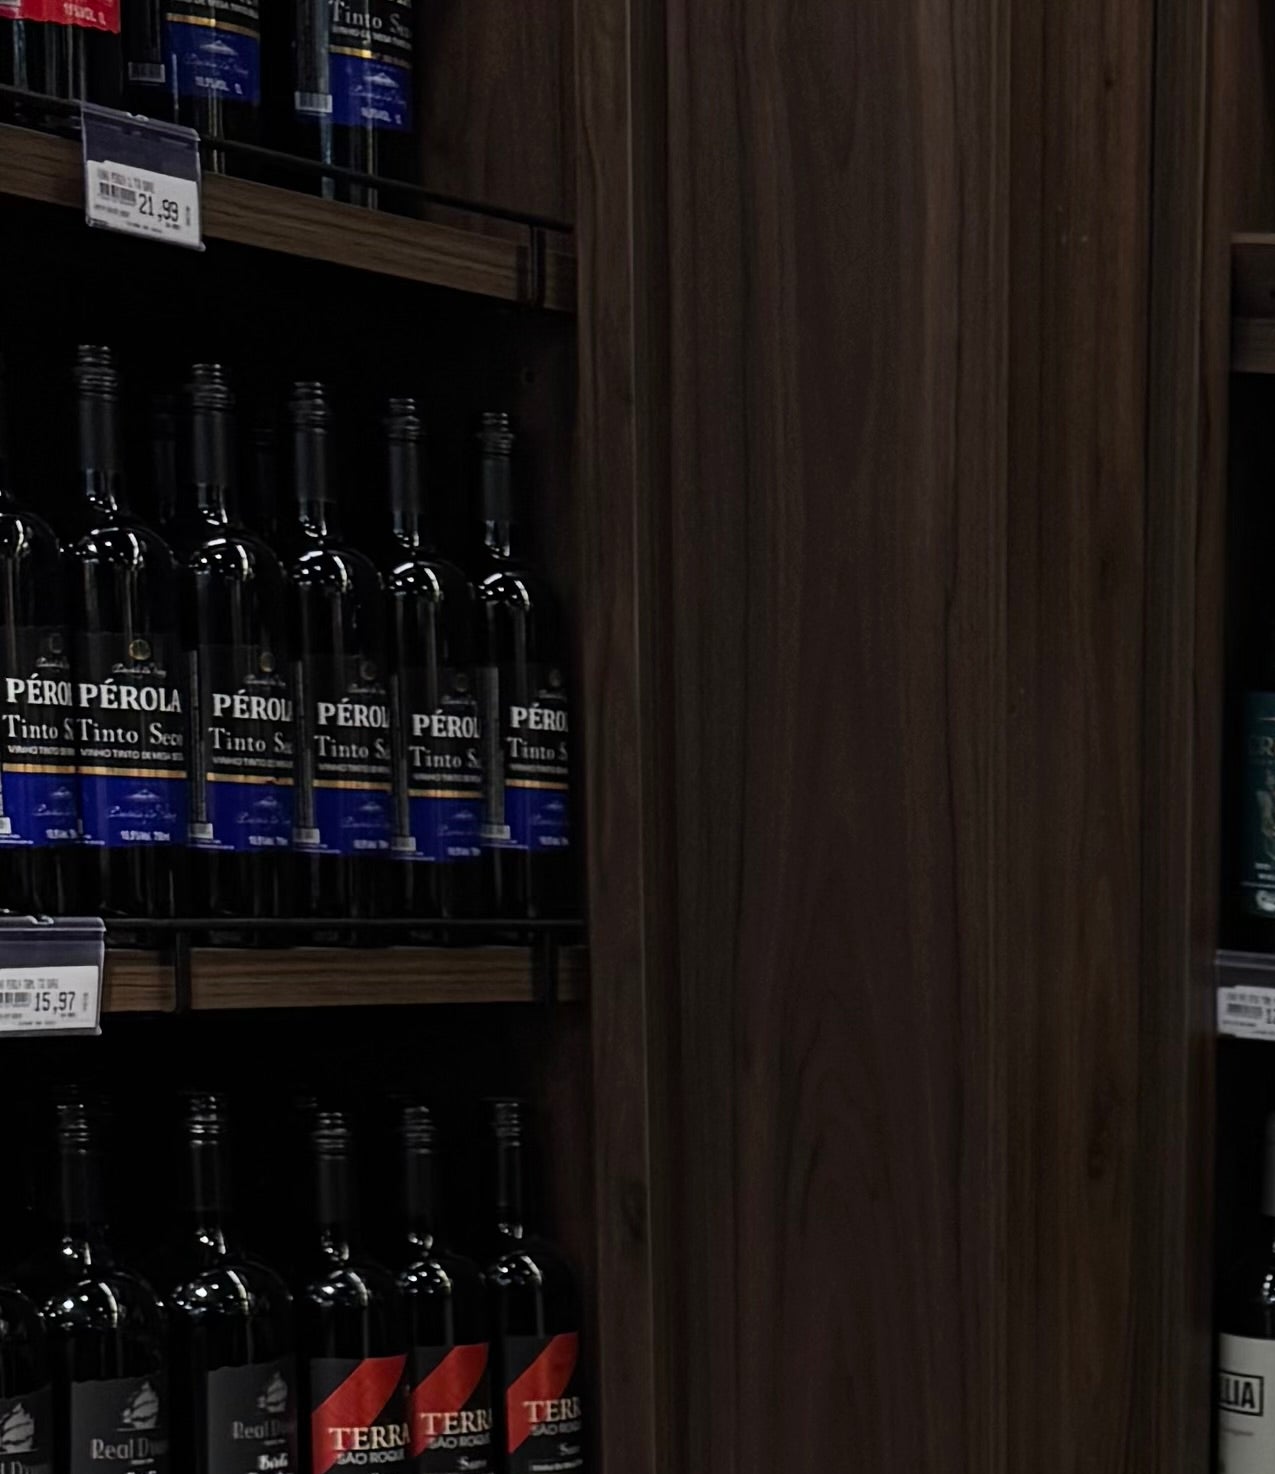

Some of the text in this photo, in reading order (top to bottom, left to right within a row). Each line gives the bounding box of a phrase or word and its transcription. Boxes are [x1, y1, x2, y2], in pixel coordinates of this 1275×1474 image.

[79, 678, 182, 714] PÉROLA
[317, 698, 390, 728] PÉROL
[412, 709, 480, 739] PÉROL
[2, 714, 58, 740] Tinto
[77, 718, 139, 744] Tinto
[208, 727, 267, 753] Tinto
[313, 735, 369, 760] Tinto
[408, 746, 462, 769] Tinto
[34, 991, 76, 1015] 15,97
[328, 1422, 411, 1451] TERRA
